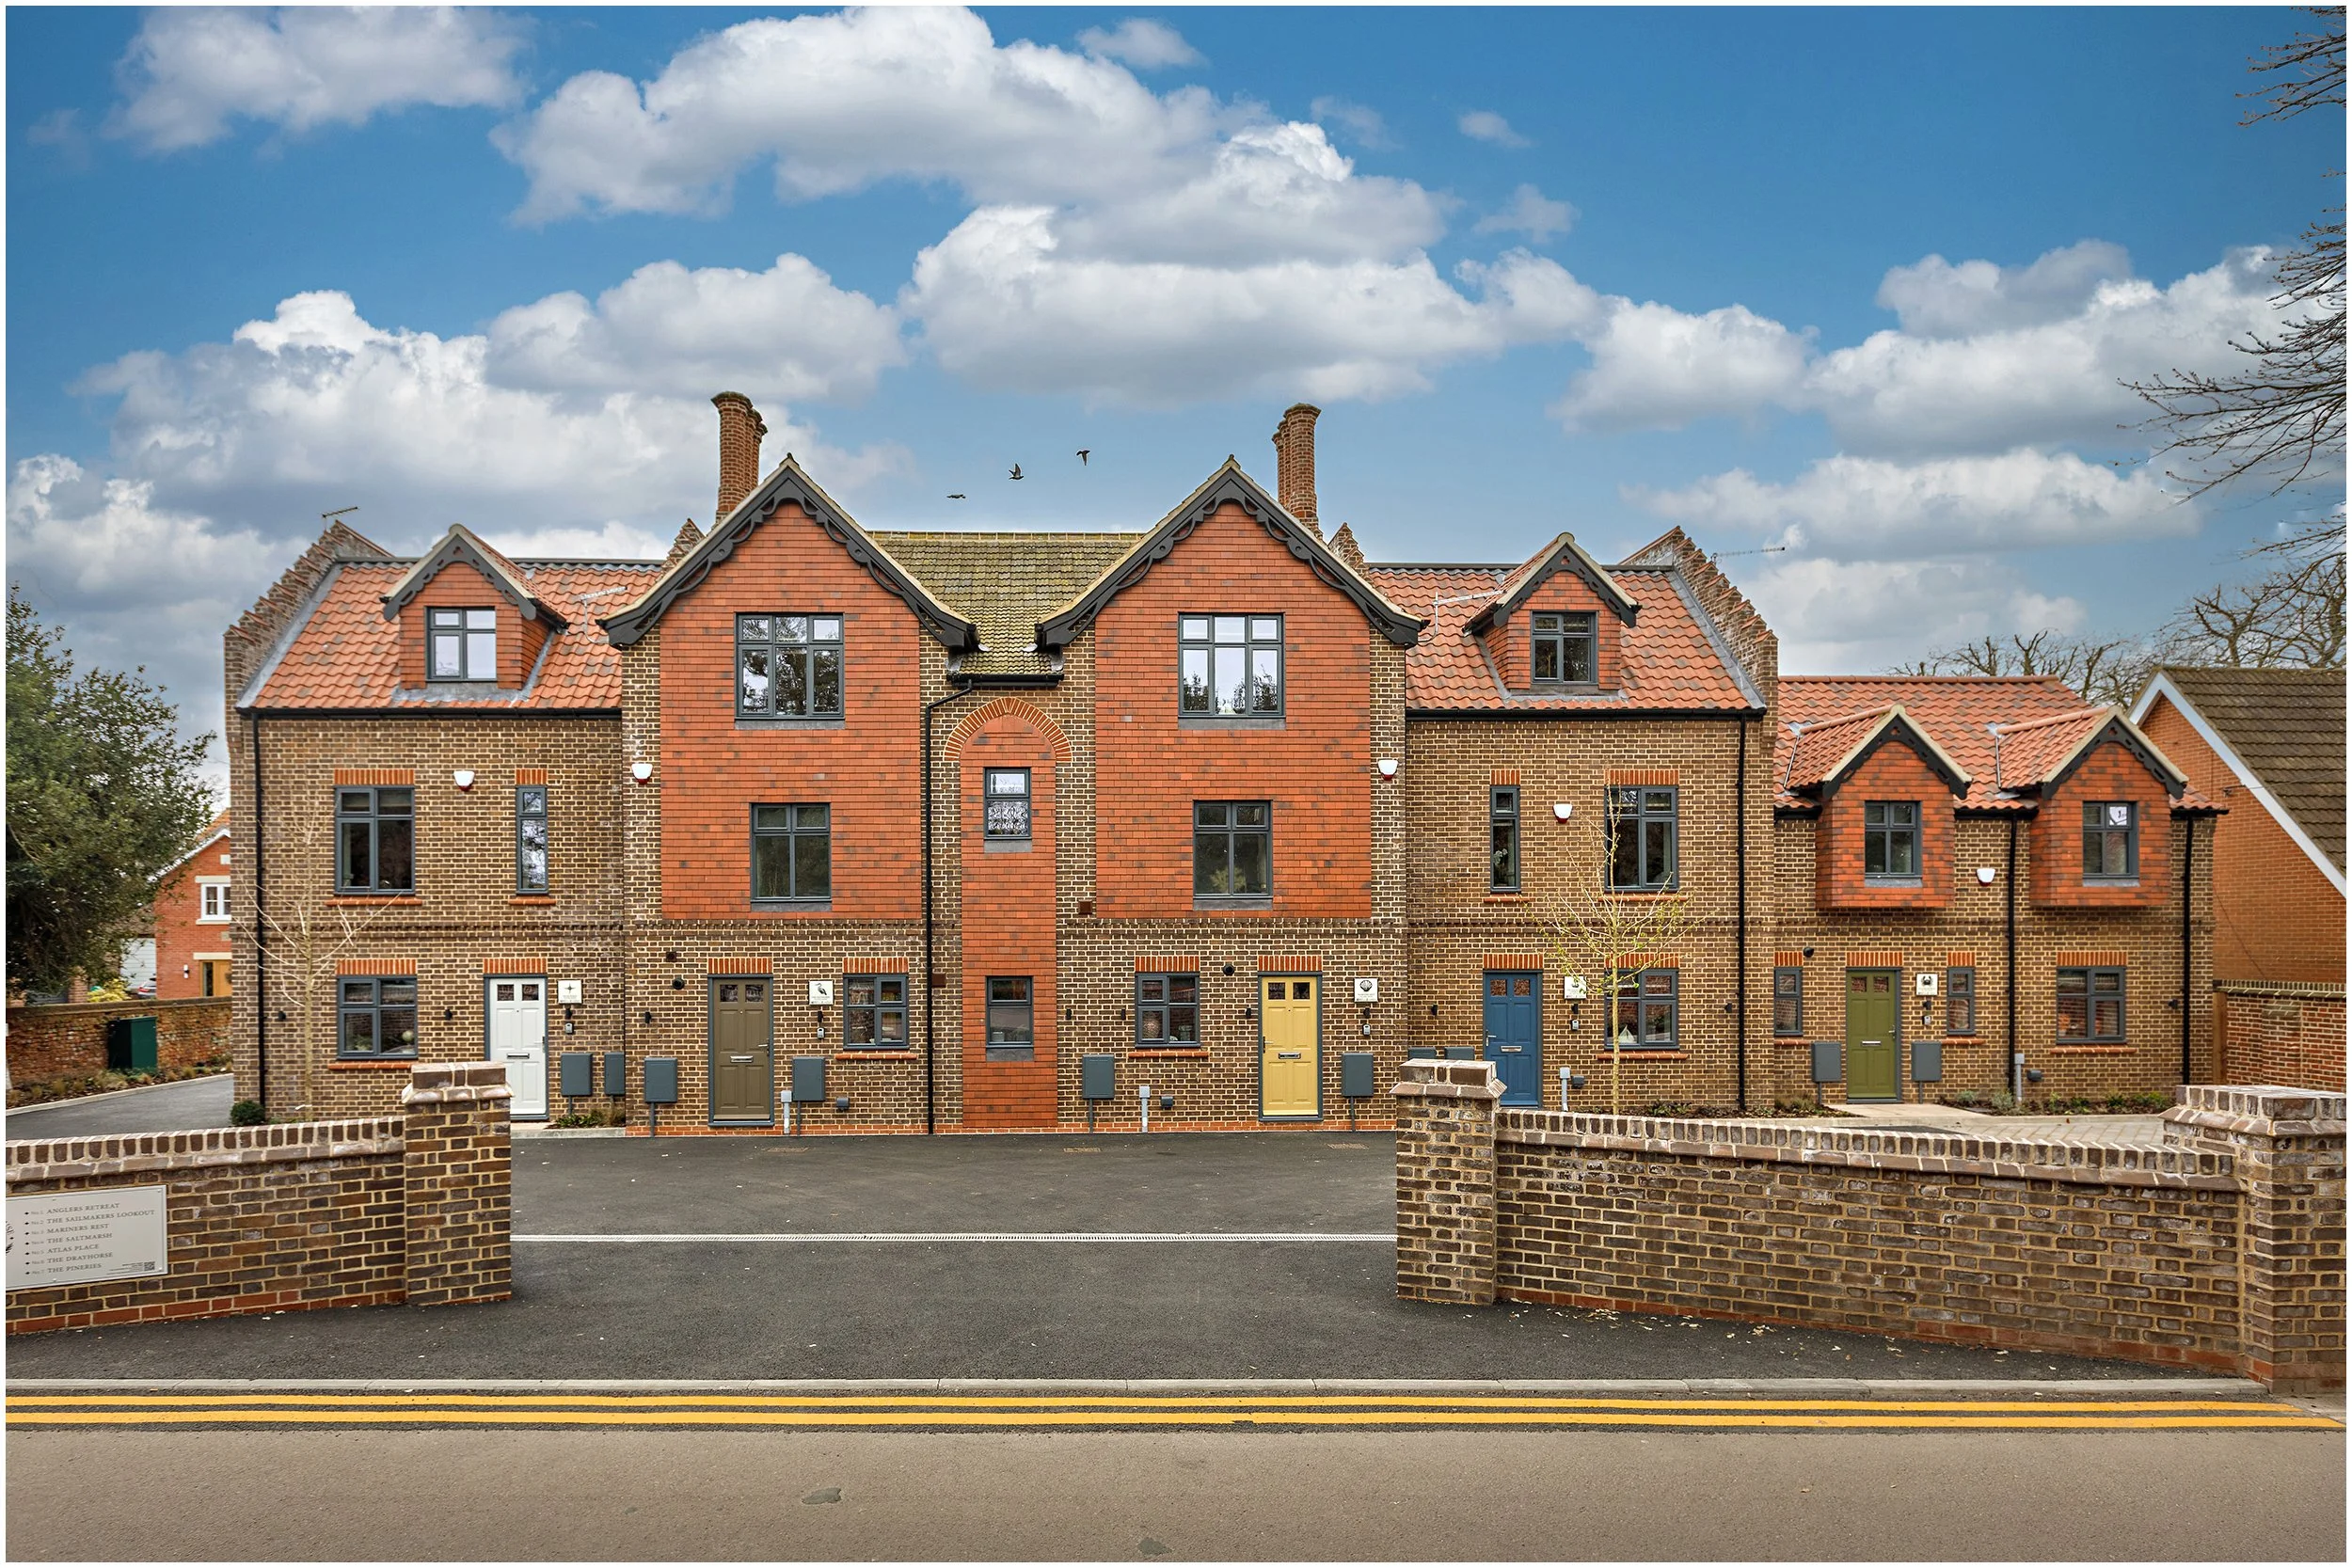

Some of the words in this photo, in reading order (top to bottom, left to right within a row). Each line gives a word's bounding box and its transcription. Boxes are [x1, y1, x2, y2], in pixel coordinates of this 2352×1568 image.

[47, 1206, 83, 1214] ANGLERS
[66, 1212, 115, 1222] SAILMAKERS
[47, 1225, 88, 1234] MARINERS
[66, 1232, 112, 1242] SALTMARSH
[66, 1262, 102, 1272] PINERIES
